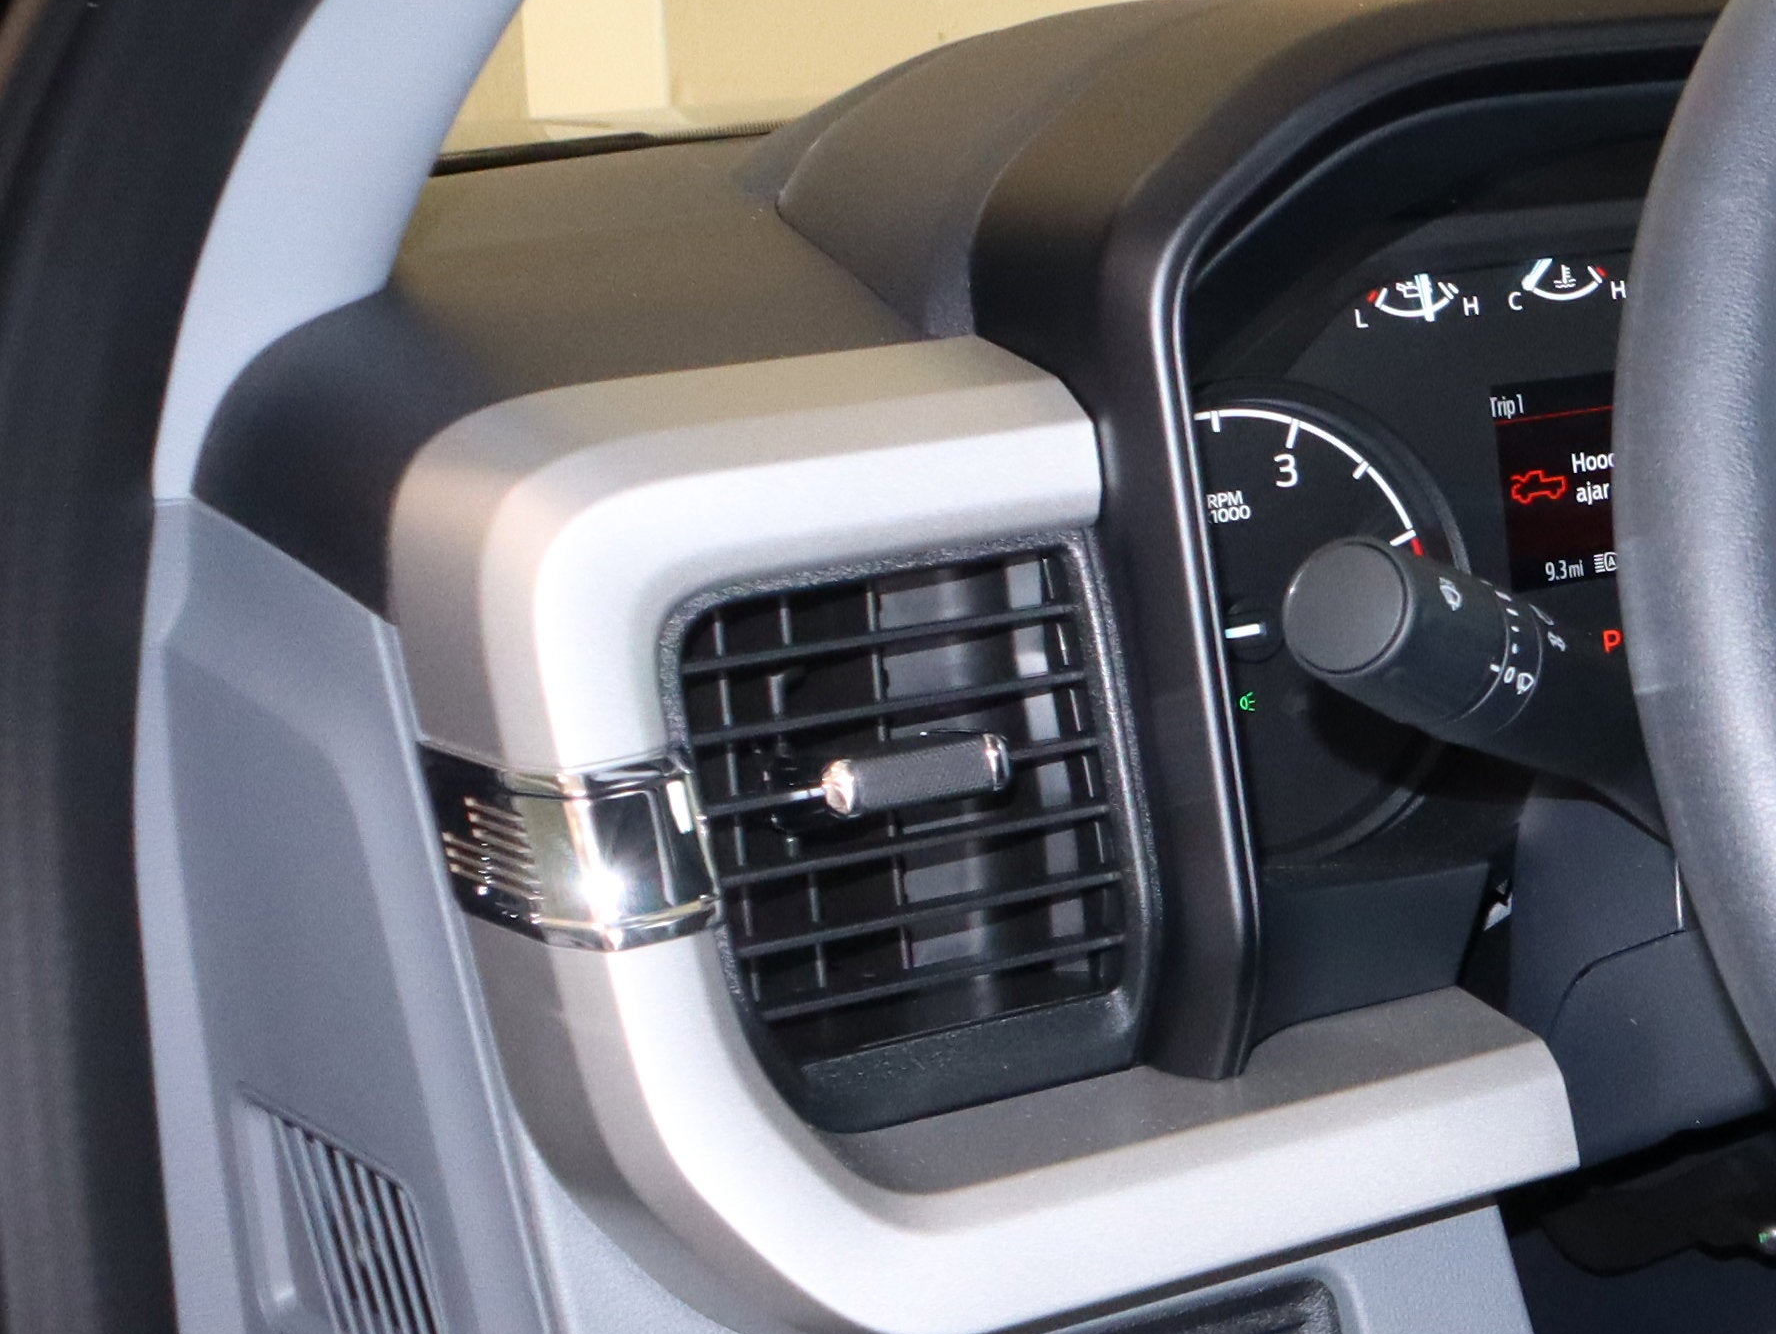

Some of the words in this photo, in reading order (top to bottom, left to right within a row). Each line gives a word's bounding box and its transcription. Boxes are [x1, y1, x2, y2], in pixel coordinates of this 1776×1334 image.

[1610, 280, 1627, 300] H
[1463, 296, 1480, 316] H
[1508, 291, 1523, 311] C
[1354, 308, 1369, 329] L
[1489, 395, 1516, 420] Trip
[1516, 394, 1525, 414] 1
[1273, 453, 1298, 488] 3
[1206, 489, 1244, 509] RPM
[1575, 482, 1611, 506] ajar
[1208, 505, 1251, 525] 1000
[1602, 629, 1622, 654] P
